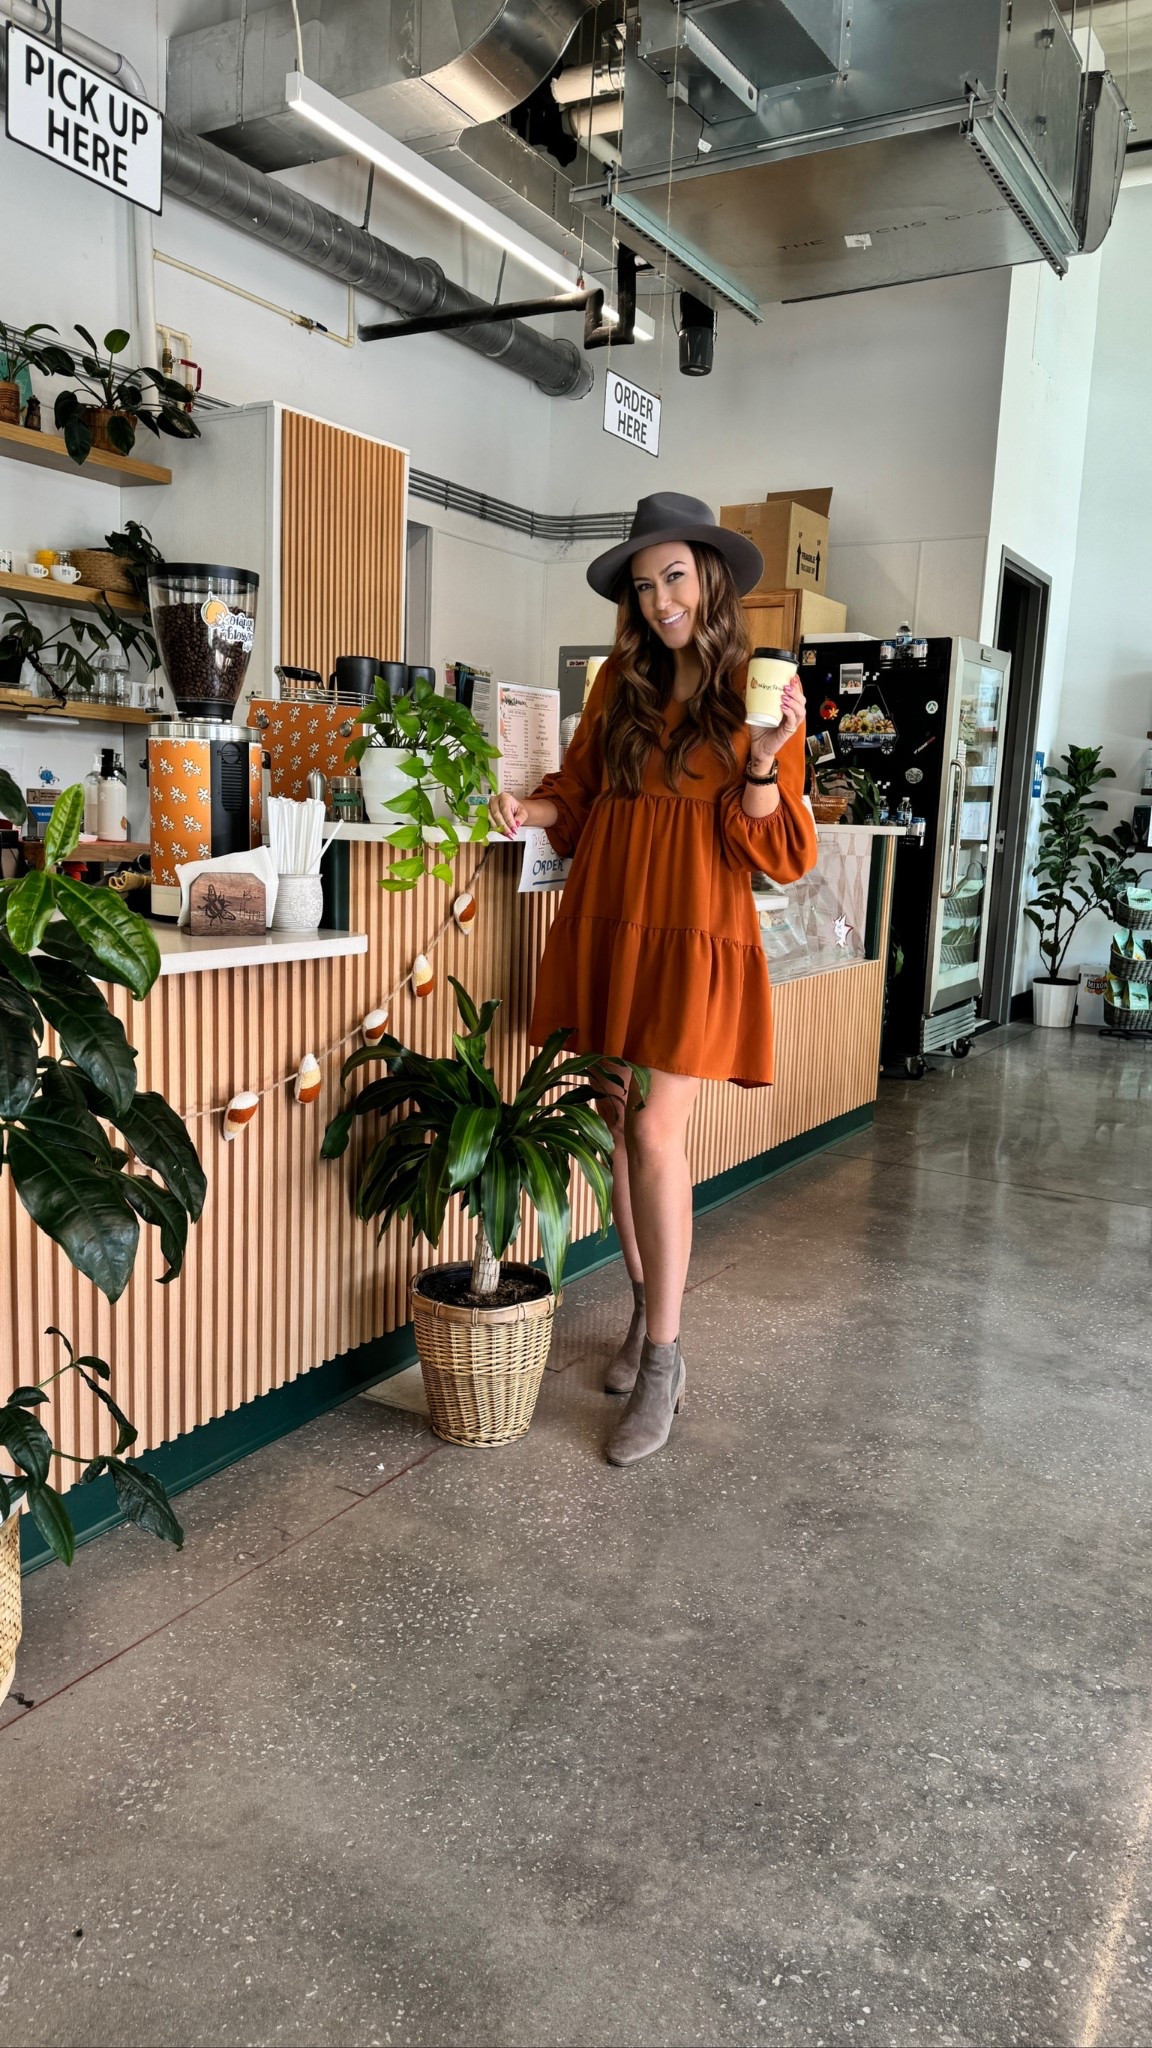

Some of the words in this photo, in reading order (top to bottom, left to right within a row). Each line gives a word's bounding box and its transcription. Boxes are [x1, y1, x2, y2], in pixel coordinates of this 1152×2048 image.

[25, 44, 99, 124] PICK
[109, 93, 148, 145] UP
[48, 107, 128, 187] HERE
[614, 381, 653, 422] ORDER
[617, 410, 647, 445] HERE
[533, 858, 564, 876] ORDER
